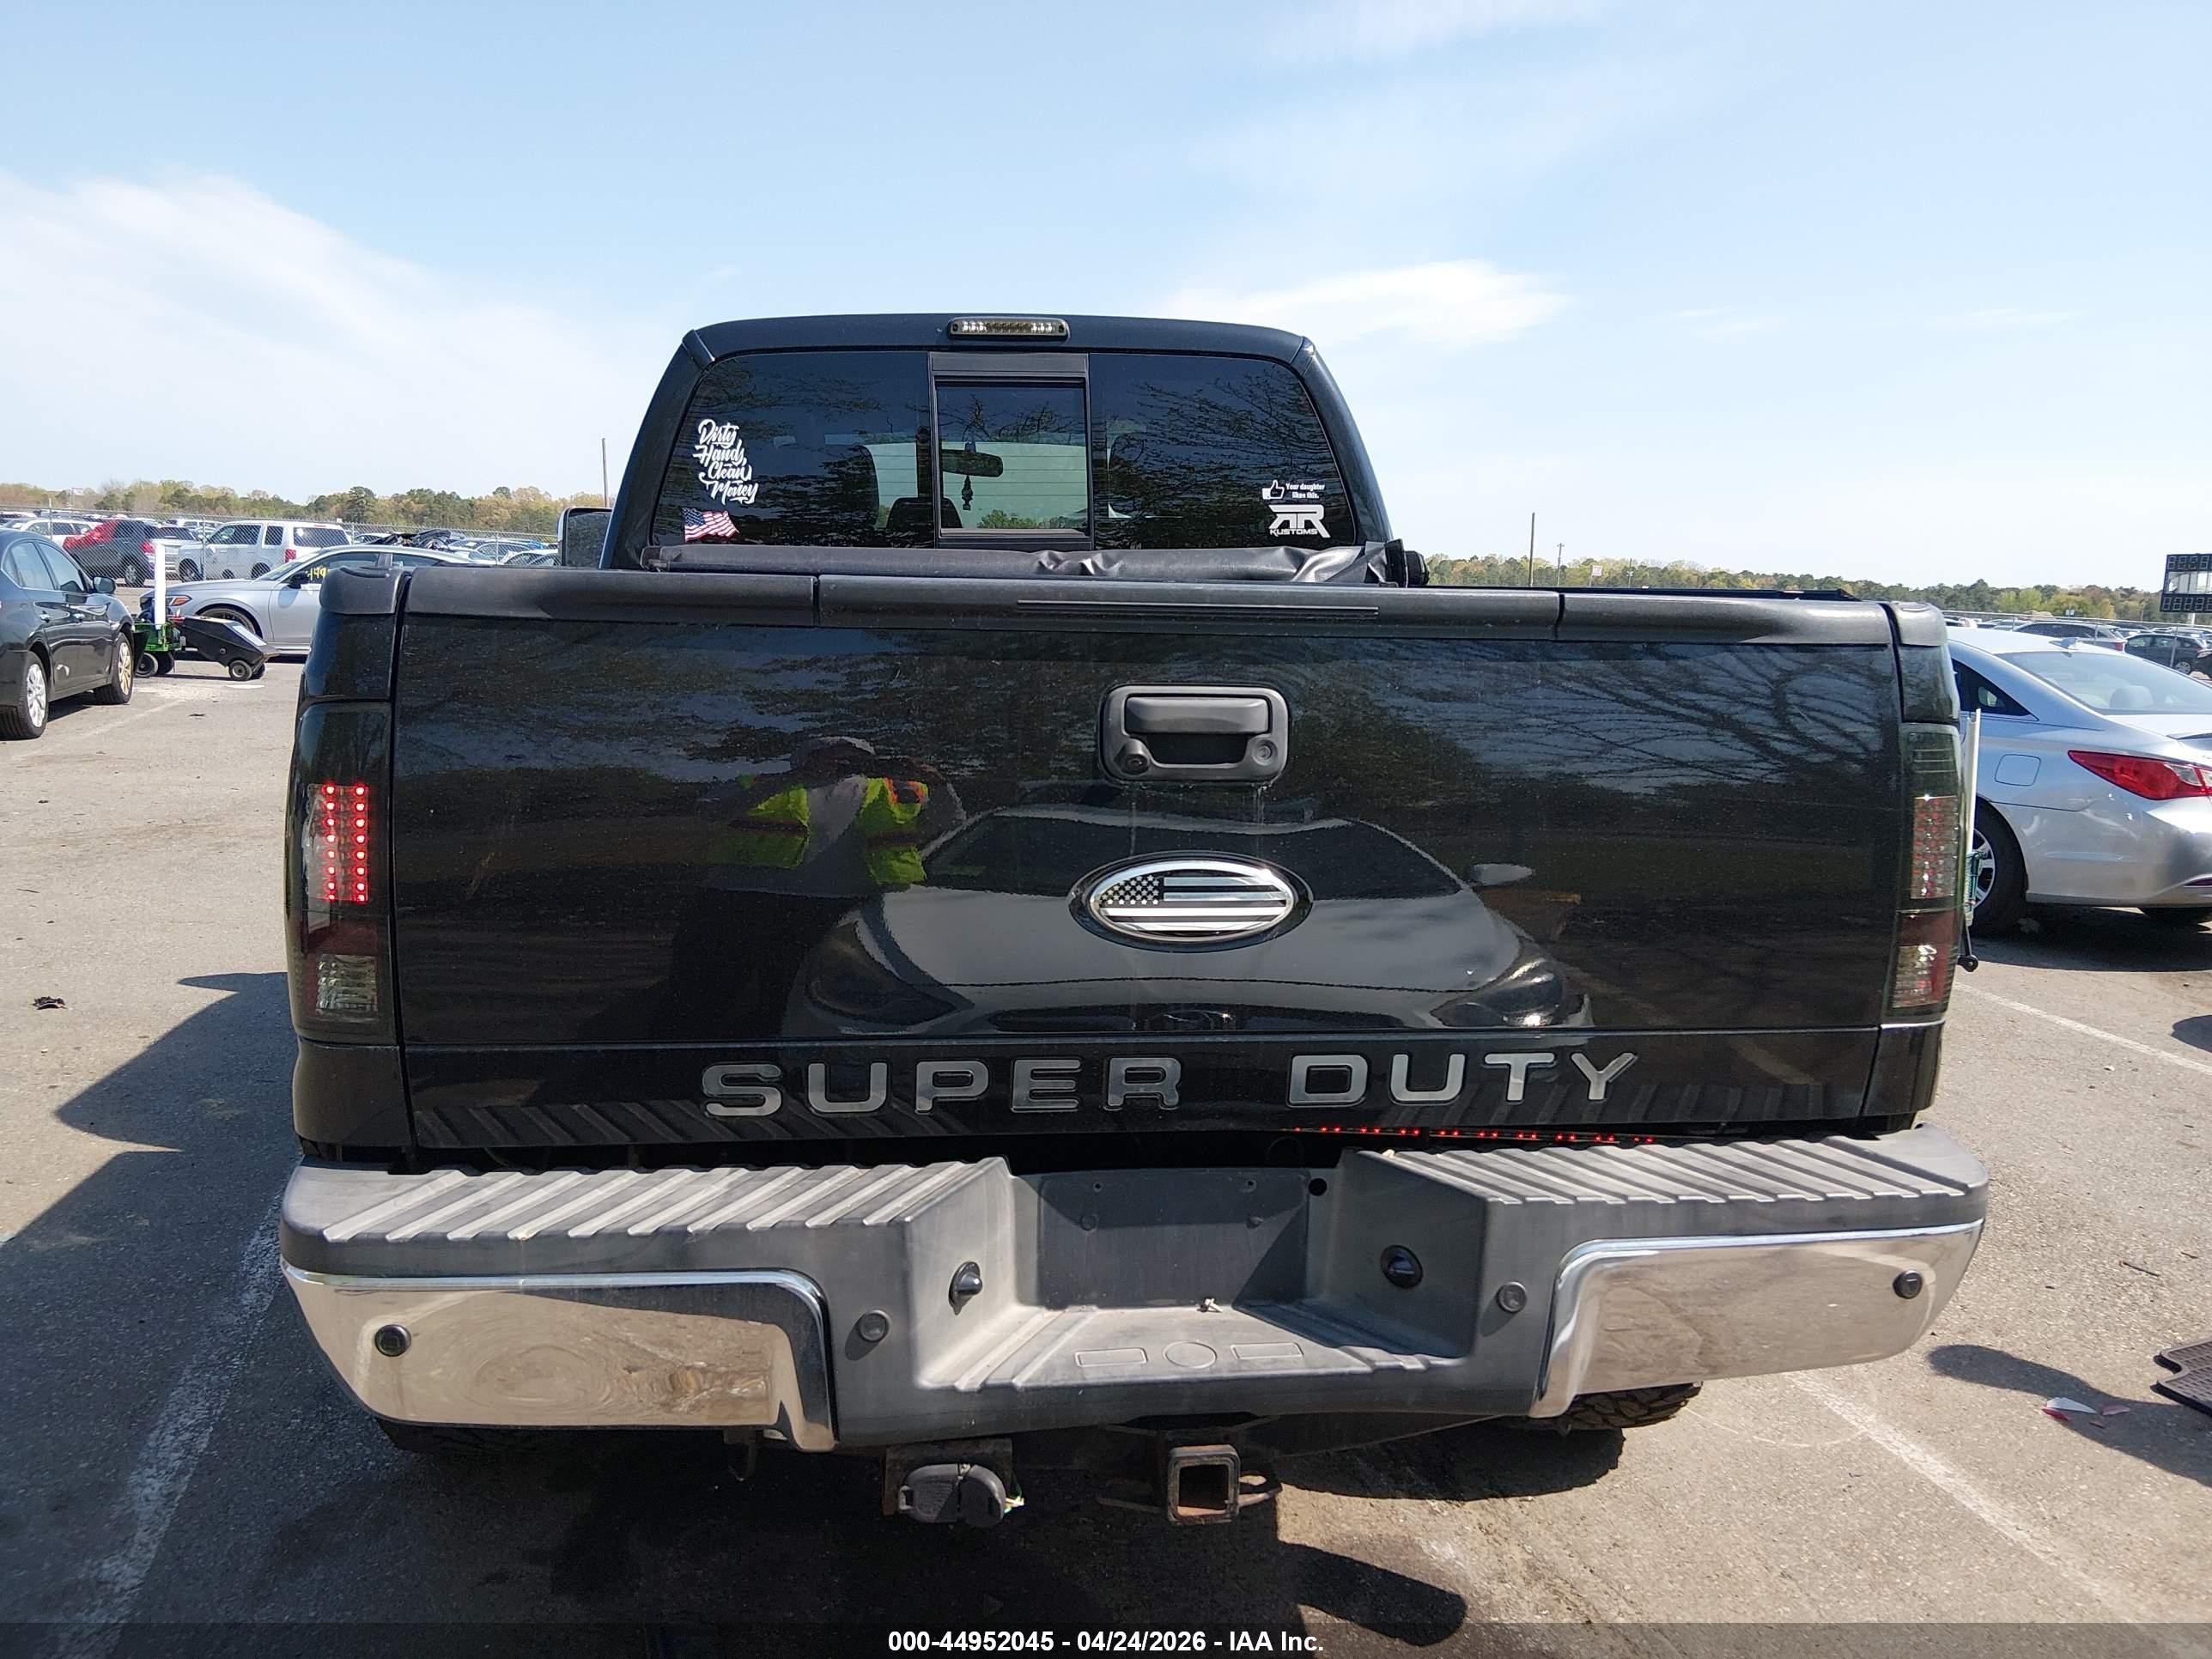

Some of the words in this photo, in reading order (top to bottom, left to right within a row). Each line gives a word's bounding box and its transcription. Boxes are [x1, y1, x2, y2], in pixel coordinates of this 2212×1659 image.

[698, 419, 739, 448] Dirty
[707, 463, 753, 482] Clean
[1300, 483, 1325, 491] daughter
[698, 471, 759, 506] Money
[702, 1056, 1181, 1119] SUPER
[1287, 1051, 1639, 1109] DUTY
